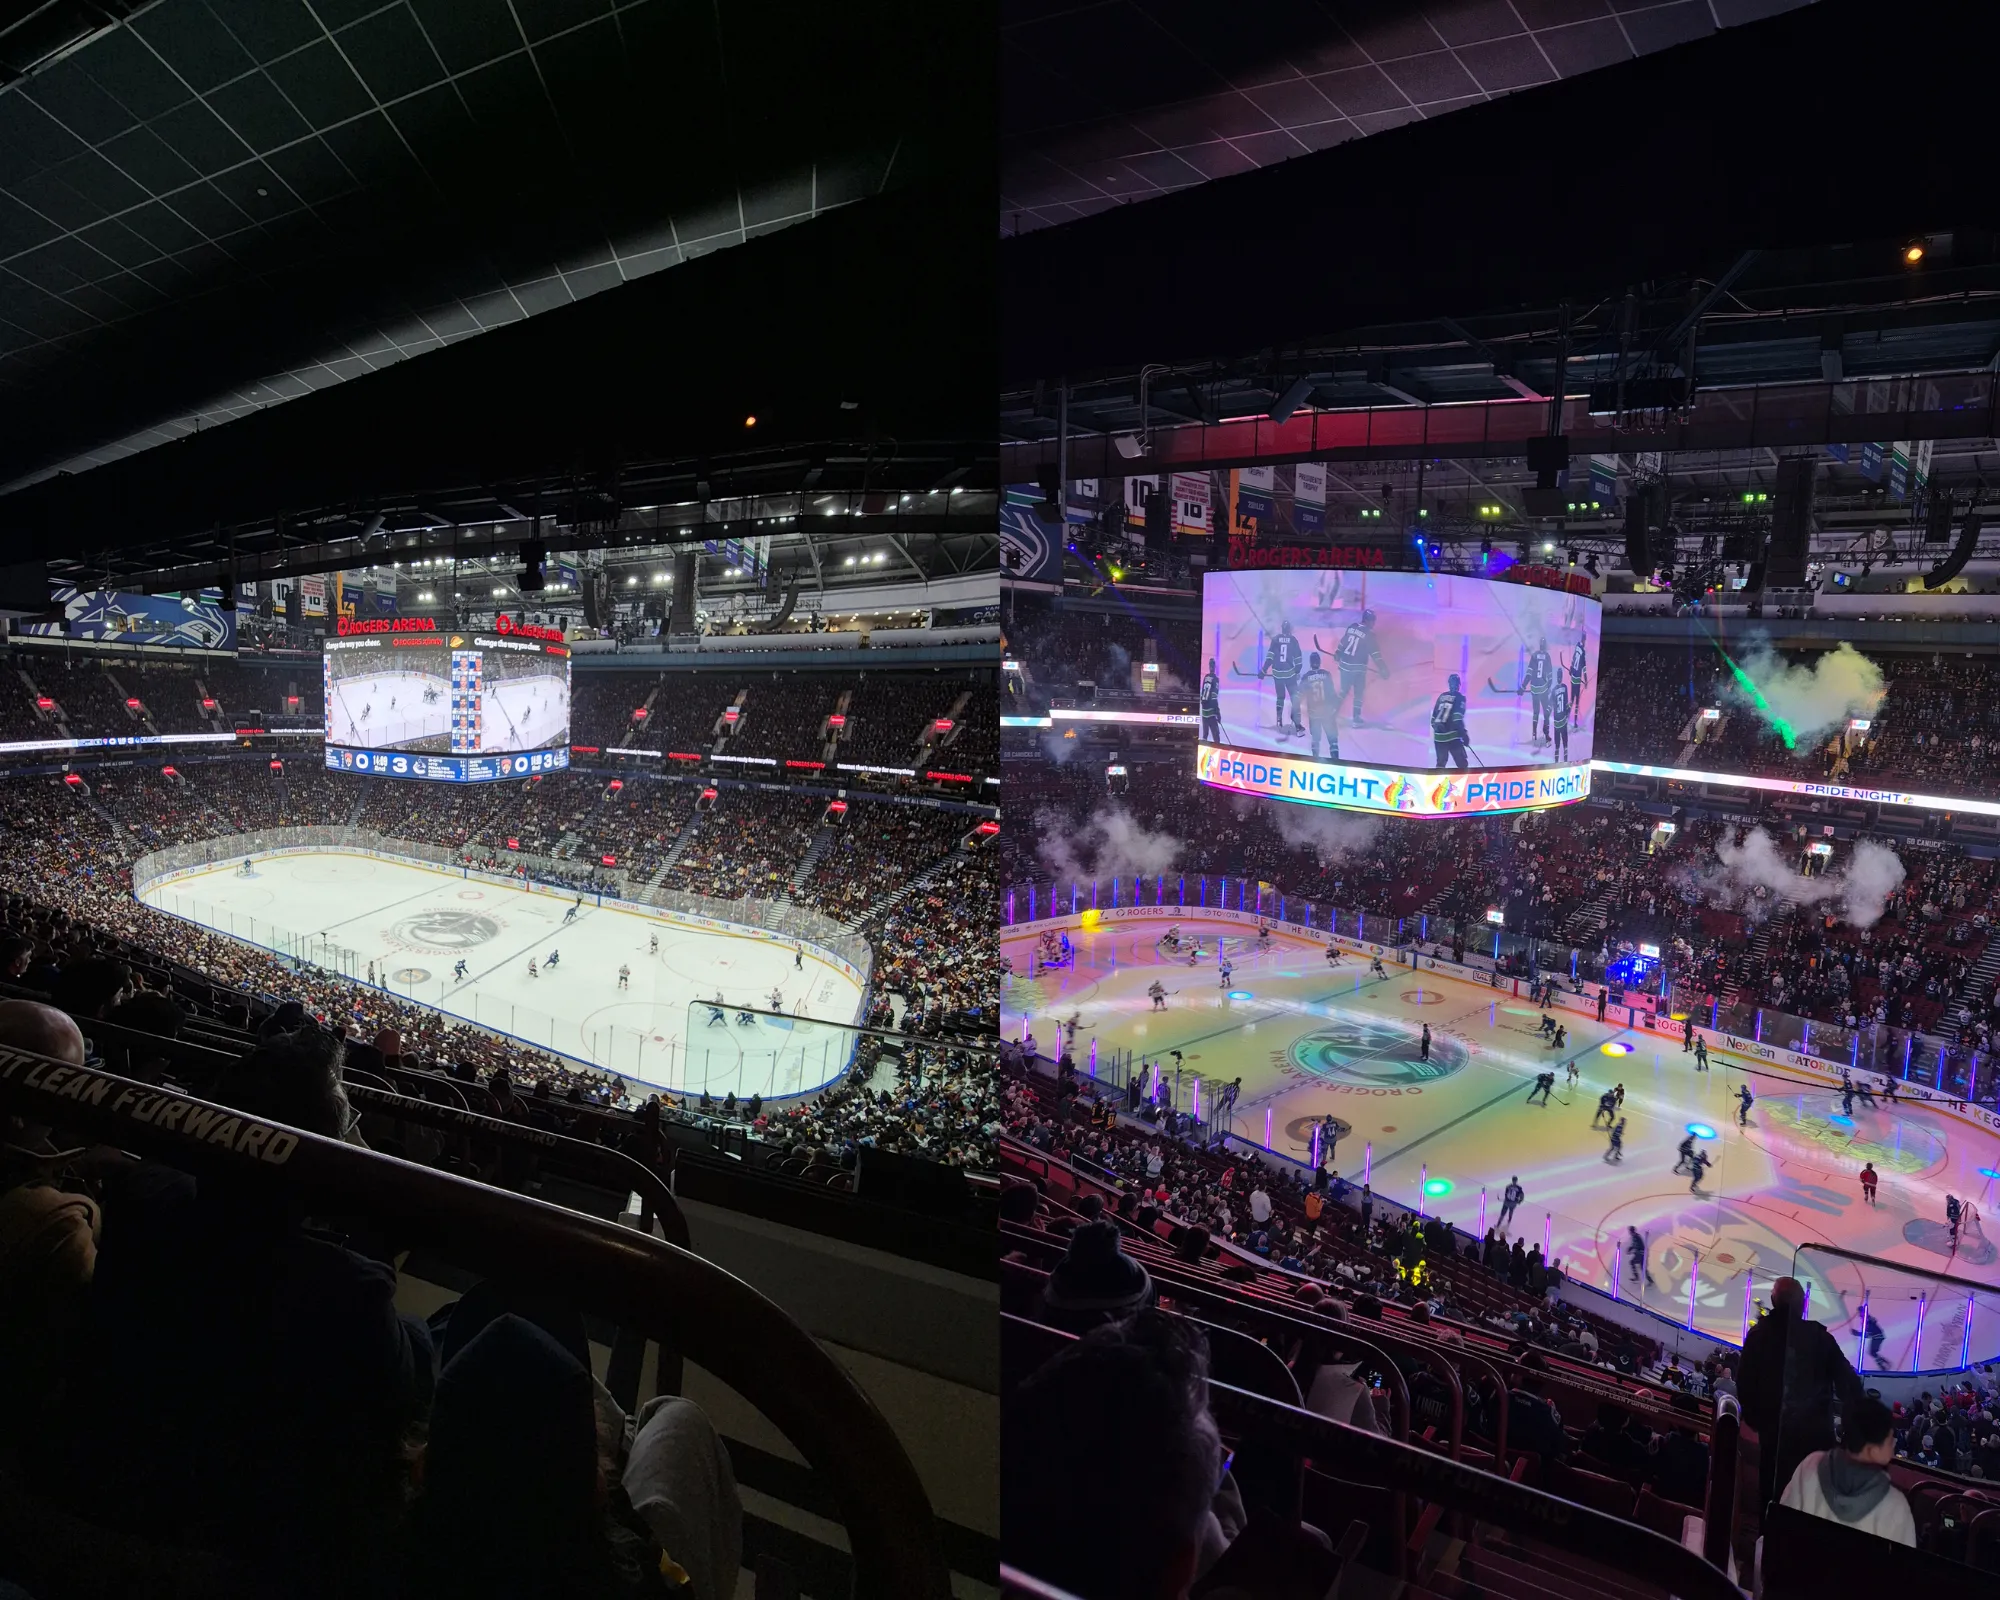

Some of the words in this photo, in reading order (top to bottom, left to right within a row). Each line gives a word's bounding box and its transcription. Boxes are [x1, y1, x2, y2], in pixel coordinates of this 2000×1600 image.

[1250, 547, 1313, 566] ROGERS
[1316, 546, 1385, 567] ARENA
[350, 619, 390, 634] ROGERS
[392, 617, 436, 632] ARENA
[326, 641, 340, 650] Change
[346, 641, 355, 649] way
[355, 641, 365, 650] you
[399, 637, 422, 646] ROGERS
[474, 637, 497, 649] Change
[497, 638, 508, 648] the
[508, 641, 518, 651] way
[1343, 635, 1360, 657] 21
[1279, 644, 1288, 663] 9
[1536, 660, 1544, 679] 9
[1434, 702, 1454, 723] 27
[356, 753, 369, 769] 0
[392, 757, 408, 773] 3
[514, 756, 529, 772] 0
[543, 753, 553, 768] 3
[868, 766, 880, 774] ready
[889, 768, 916, 776] everything
[1219, 759, 1283, 787] PRIDE
[1289, 769, 1380, 800] NIGHT
[1466, 779, 1536, 804] PRIDE
[1539, 774, 1581, 798] NIGHT
[920, 799, 941, 807] CANUCKS
[1805, 784, 1850, 797] PRIDE
[1853, 789, 1902, 803] NIGHT
[1722, 813, 1730, 821] WE
[1730, 814, 1740, 822] ARE
[1741, 816, 1751, 824] ALL
[1906, 837, 1916, 845] GO
[612, 901, 639, 911] ROGERS
[656, 909, 686, 921] NexGen
[1127, 907, 1164, 917] ROGERS
[1212, 910, 1240, 920] TOYOTA
[1286, 924, 1302, 935] THE
[1305, 928, 1321, 939] KEG
[1726, 1036, 1776, 1060] NexGen
[1786, 1053, 1852, 1079] GATORADE
[24, 1062, 115, 1107] LEAN
[112, 1086, 300, 1166] FORWARD
[1973, 1107, 2000, 1129] KEG
[1595, 1388, 1608, 1397] NOT
[1609, 1393, 1626, 1403] LEAN
[1627, 1399, 1660, 1414] FORWARD
